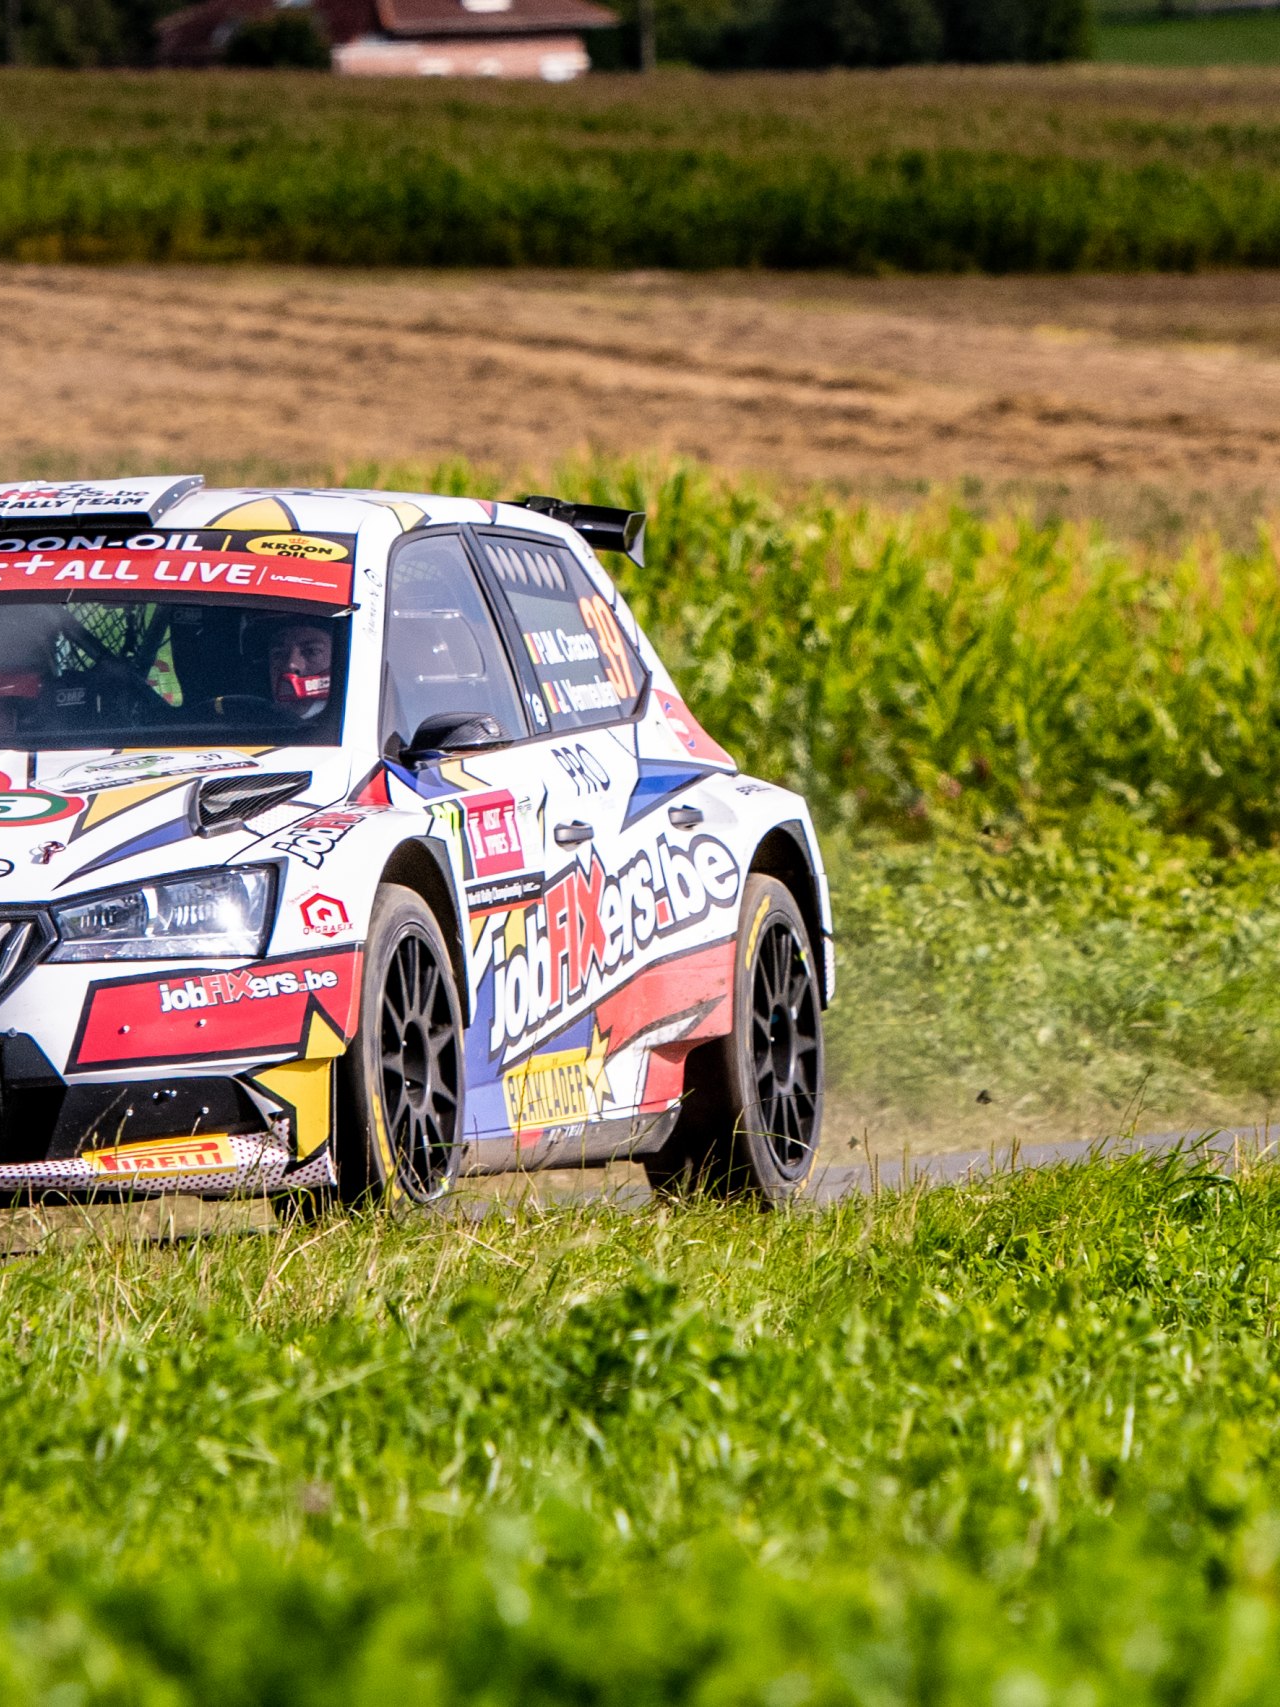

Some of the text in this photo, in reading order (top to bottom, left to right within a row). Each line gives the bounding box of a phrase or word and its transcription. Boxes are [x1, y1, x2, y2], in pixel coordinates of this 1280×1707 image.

[76, 497, 143, 507] TEAM
[260, 541, 333, 555] KROON
[277, 551, 307, 560] OIL
[54, 560, 138, 581] ALL
[153, 560, 256, 585] LIVE
[550, 743, 610, 796] PRO
[489, 833, 740, 1054] jobFIXers.be
[159, 969, 339, 1013] jobFIXers.be
[98, 1142, 223, 1171] PIRELLI
